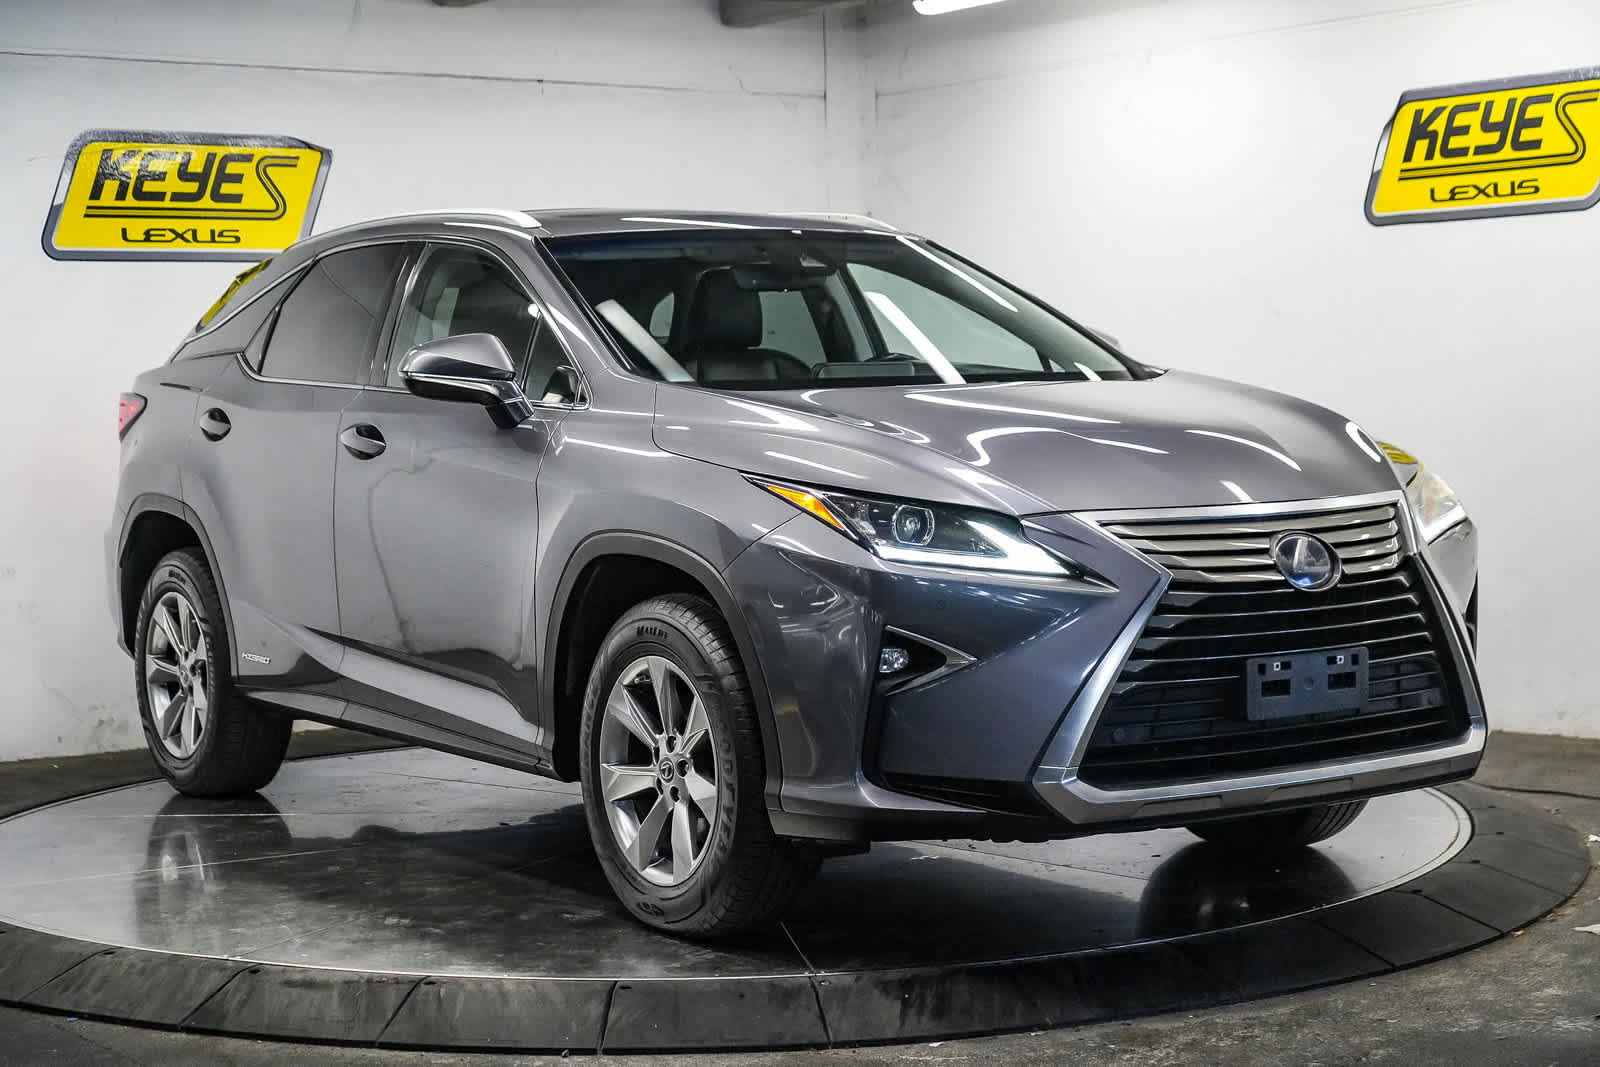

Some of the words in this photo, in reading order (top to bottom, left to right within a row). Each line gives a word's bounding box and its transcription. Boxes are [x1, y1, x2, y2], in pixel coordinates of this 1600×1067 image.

[1400, 89, 1600, 180] KEYES
[84, 149, 299, 219] KEYES
[1430, 179, 1540, 203] LEXUS
[121, 227, 241, 244] LEXUS
